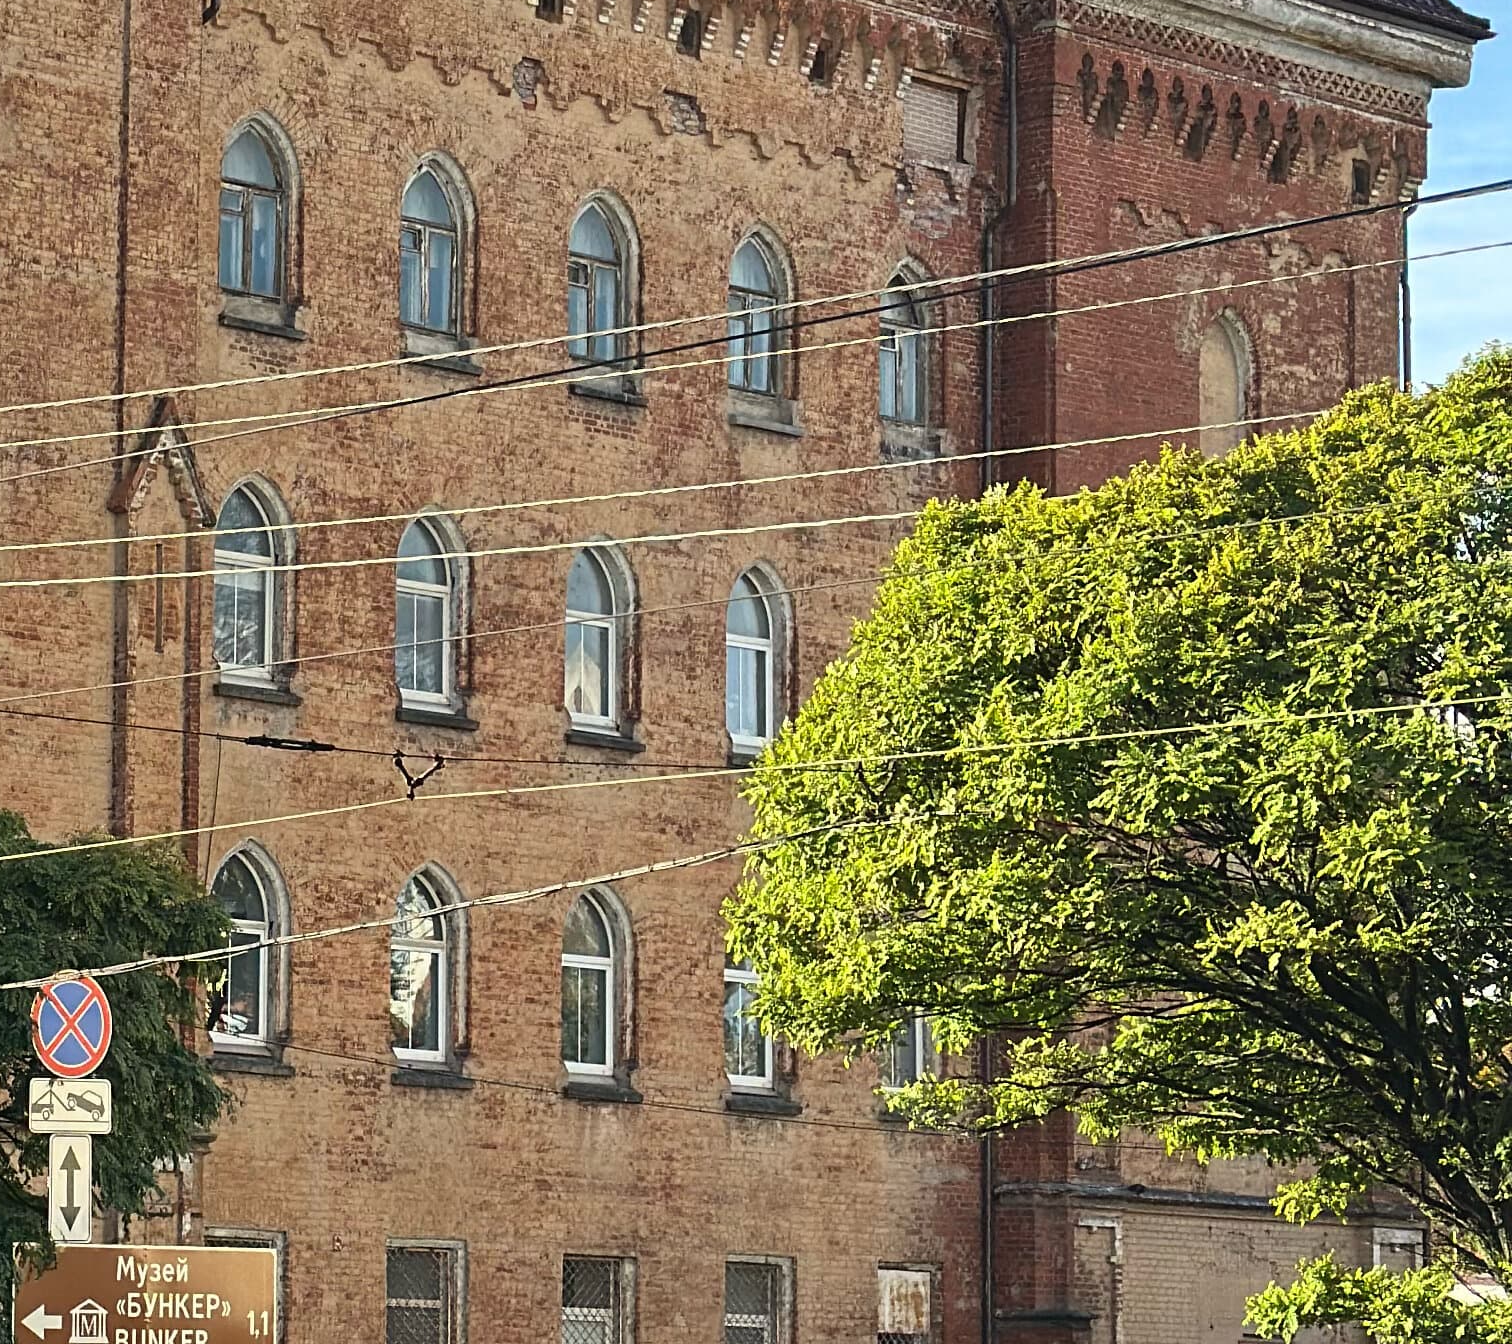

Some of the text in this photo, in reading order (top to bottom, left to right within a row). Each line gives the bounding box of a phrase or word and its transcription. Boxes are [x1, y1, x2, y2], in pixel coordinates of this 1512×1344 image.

[116, 1256, 188, 1288] Музей
[116, 1292, 231, 1319] «БУНКЕР»
[247, 1310, 269, 1339] 1,1
